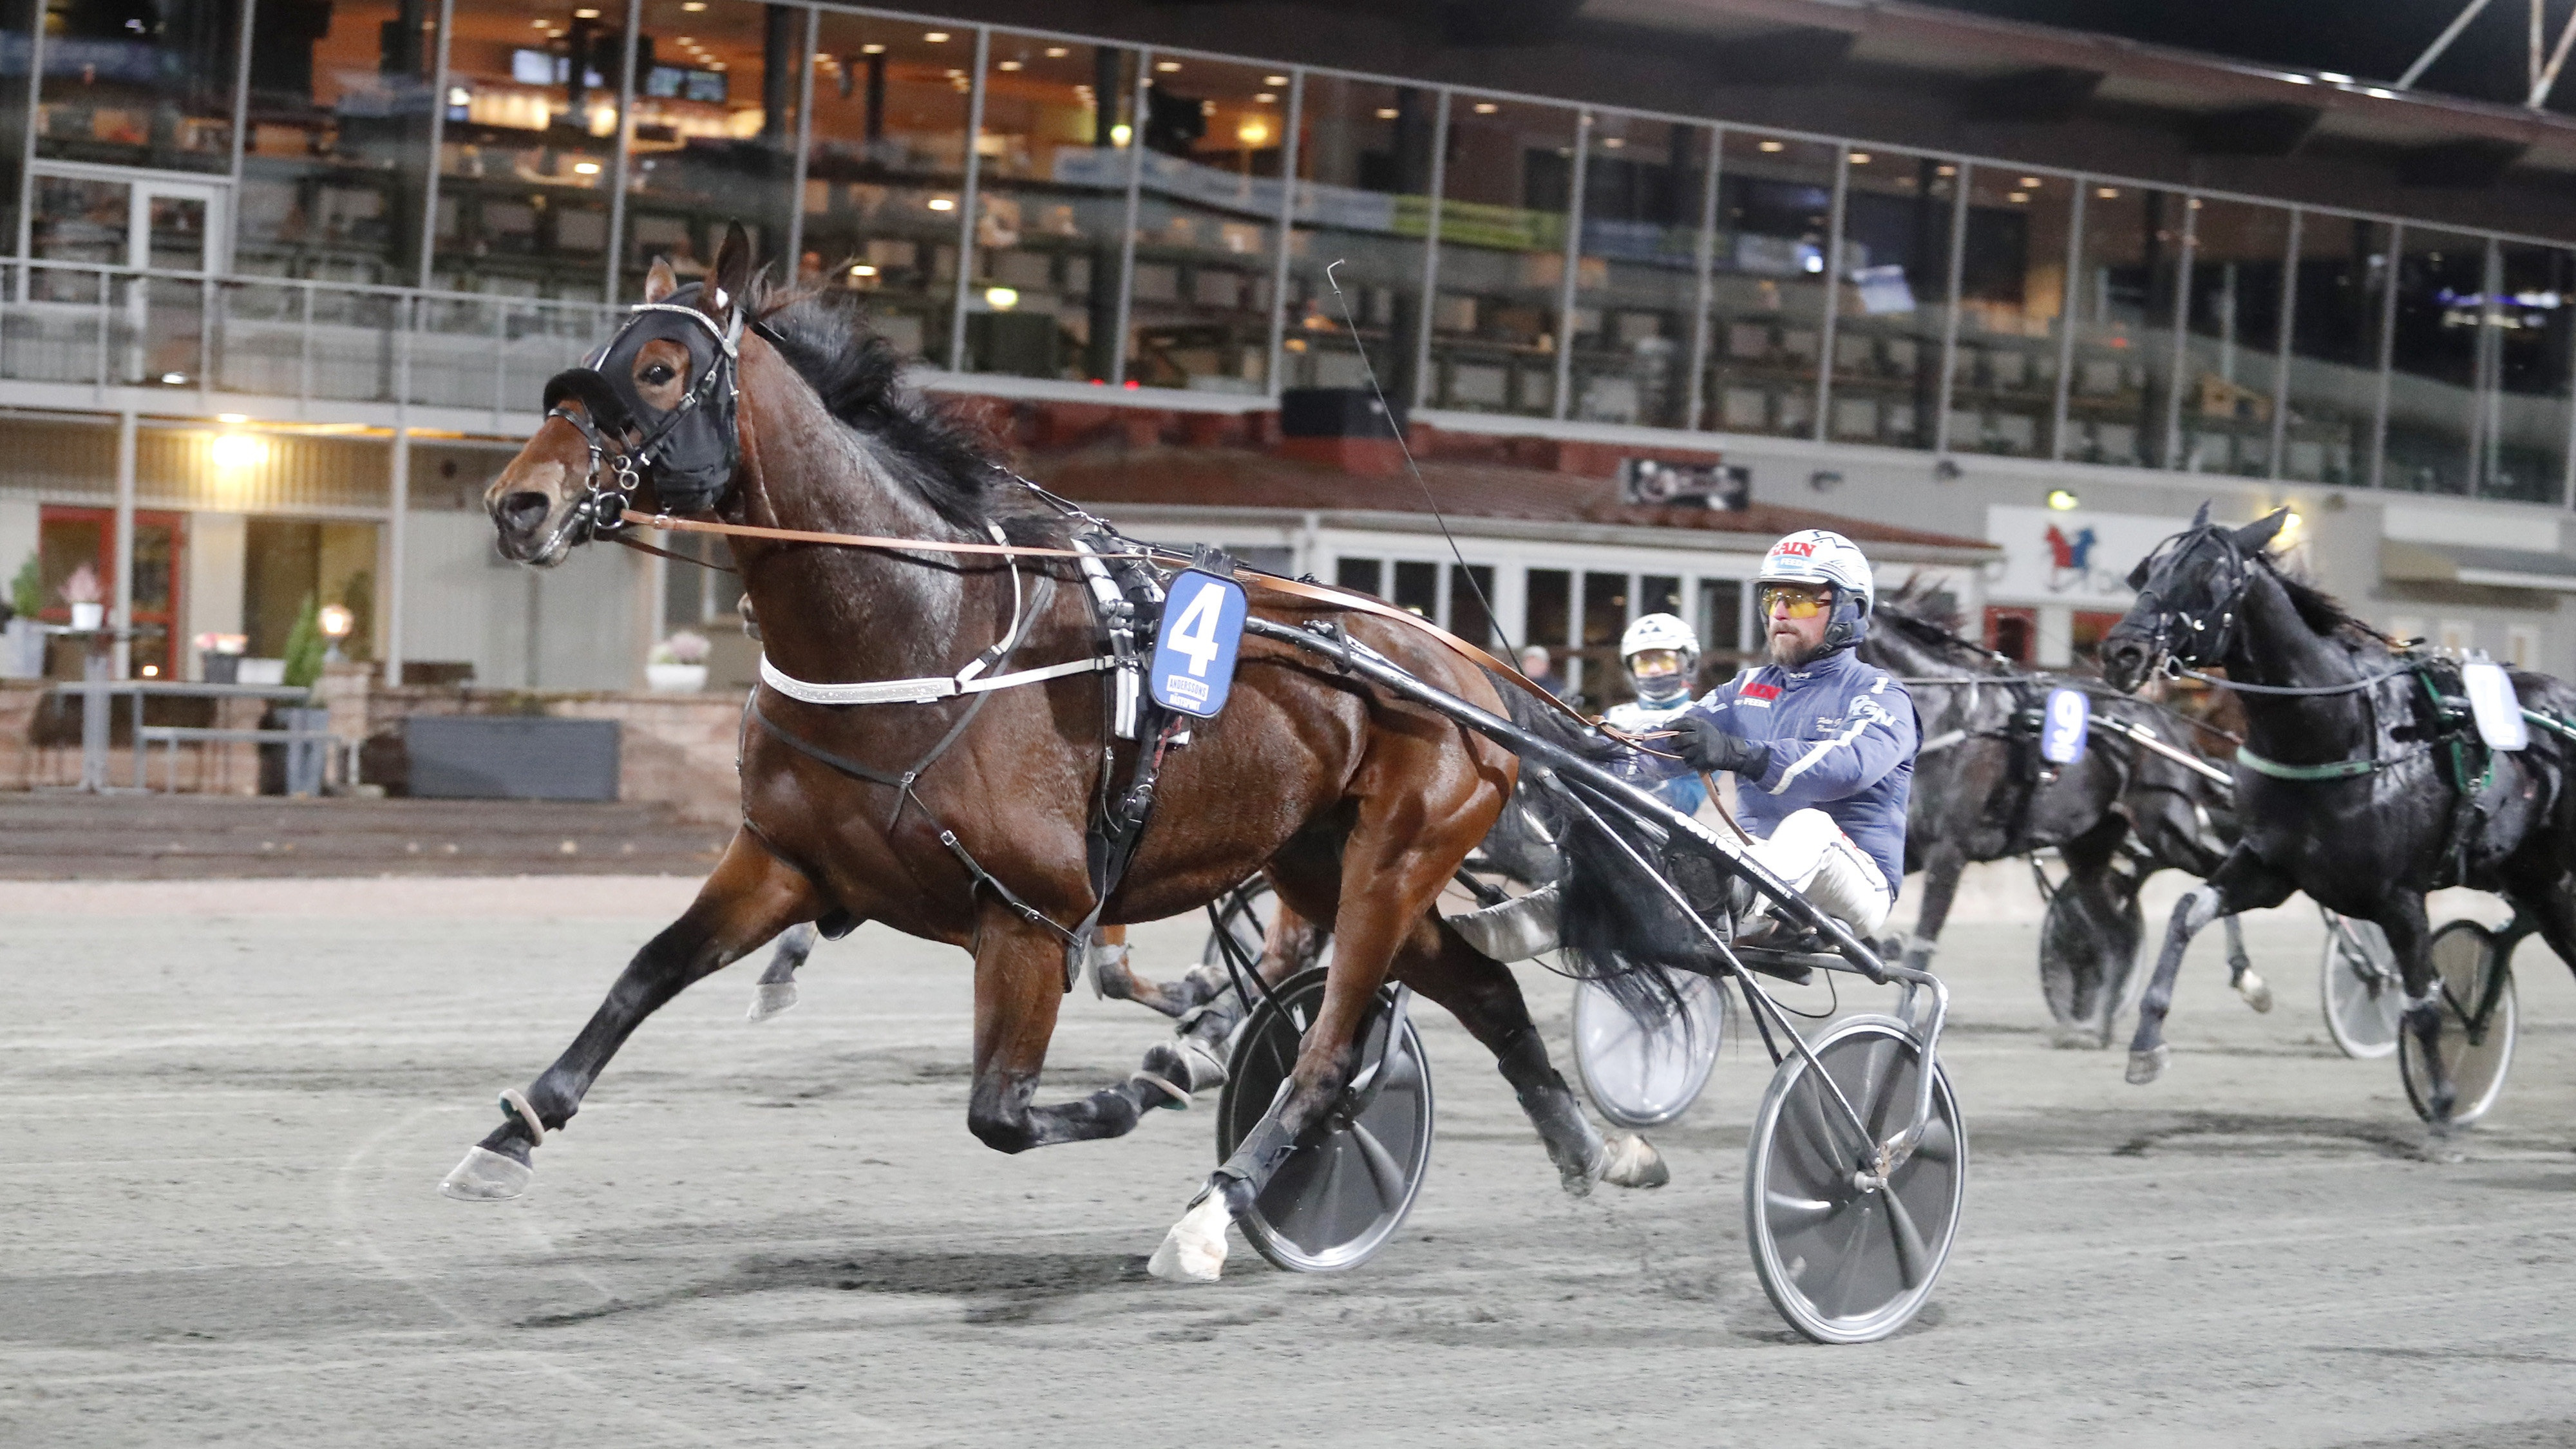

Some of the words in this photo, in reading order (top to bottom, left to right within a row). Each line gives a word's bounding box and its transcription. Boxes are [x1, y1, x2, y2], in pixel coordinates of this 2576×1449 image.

[1167, 582, 1226, 677] 4
[1170, 678, 1207, 697] ANDERSSONS
[1743, 697, 1771, 708] FEEDS
[2054, 690, 2083, 744] 9
